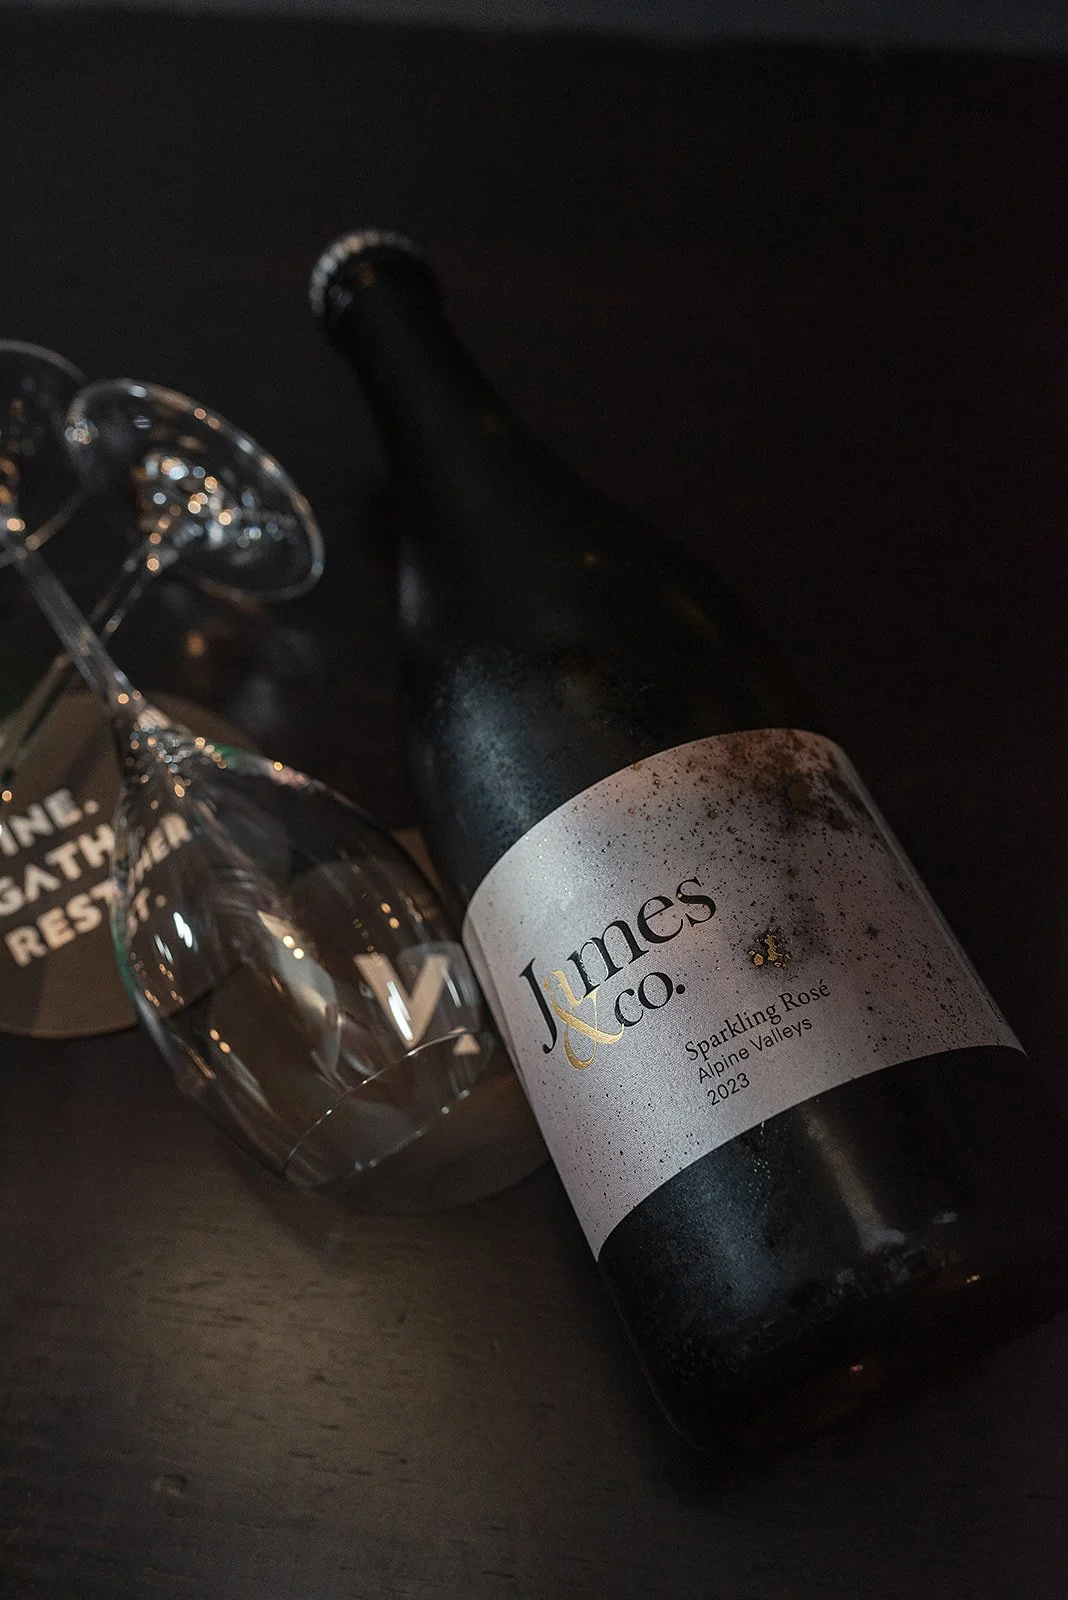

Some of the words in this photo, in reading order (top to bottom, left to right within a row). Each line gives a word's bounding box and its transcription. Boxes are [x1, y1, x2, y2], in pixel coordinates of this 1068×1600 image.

[0, 788, 99, 856] INE.
[614, 971, 686, 1028] co.
[684, 1004, 782, 1062] Sparkling
[777, 978, 831, 1013] Rosé
[698, 1048, 750, 1084] Alpine
[749, 1018, 813, 1051] Valleys
[706, 1072, 750, 1106] 2023
